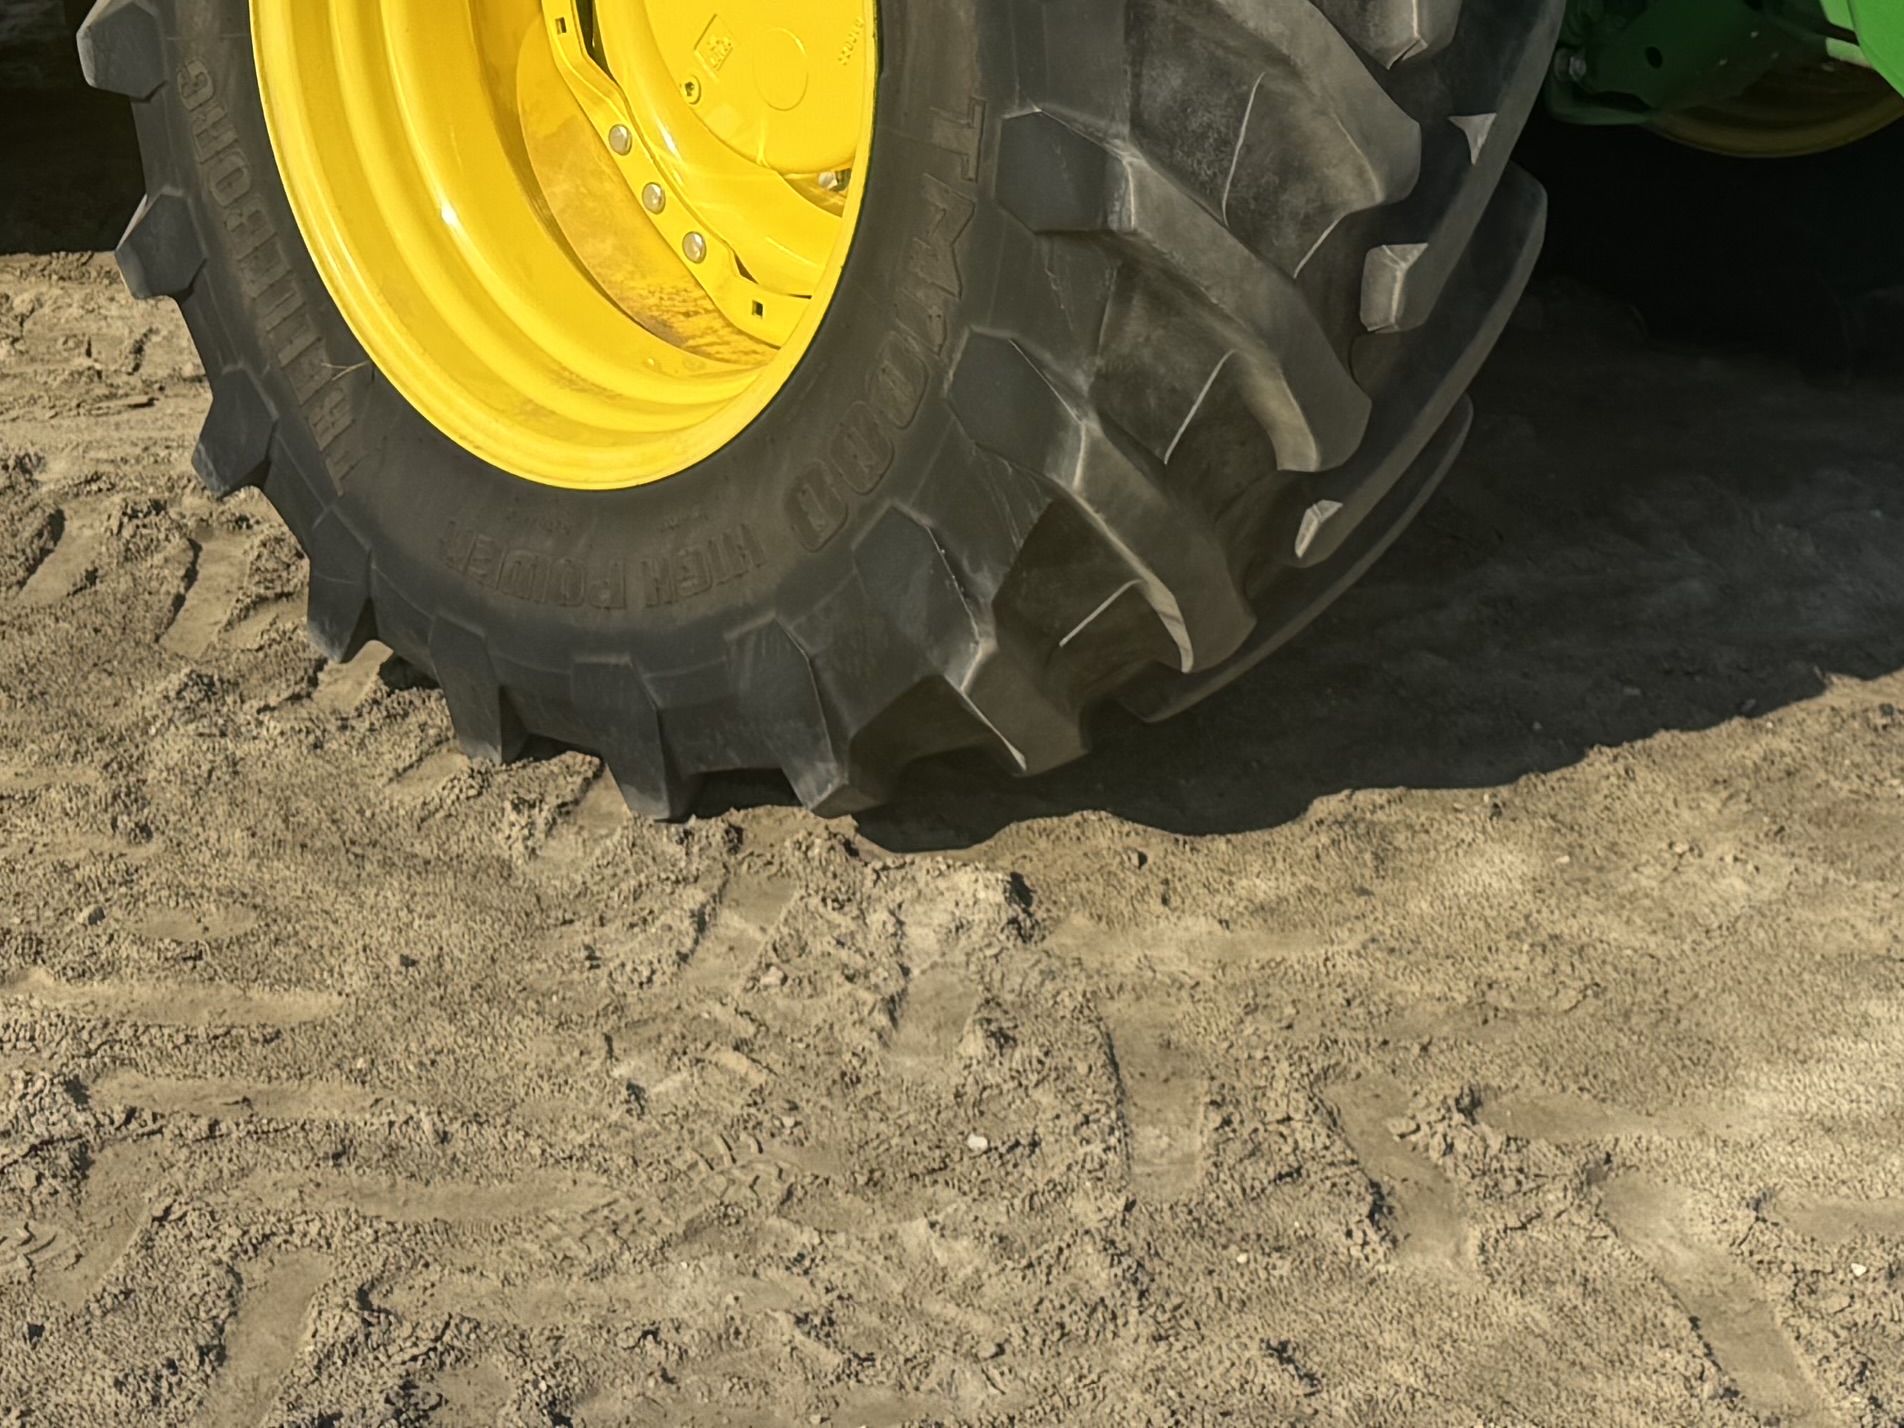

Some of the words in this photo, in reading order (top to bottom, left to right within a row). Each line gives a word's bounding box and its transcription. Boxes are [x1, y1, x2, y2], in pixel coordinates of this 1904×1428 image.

[177, 59, 382, 495] TRELLEBORG
[790, 96, 986, 553] TM1000
[438, 519, 627, 612] POWER
[641, 522, 767, 608] HIGH
